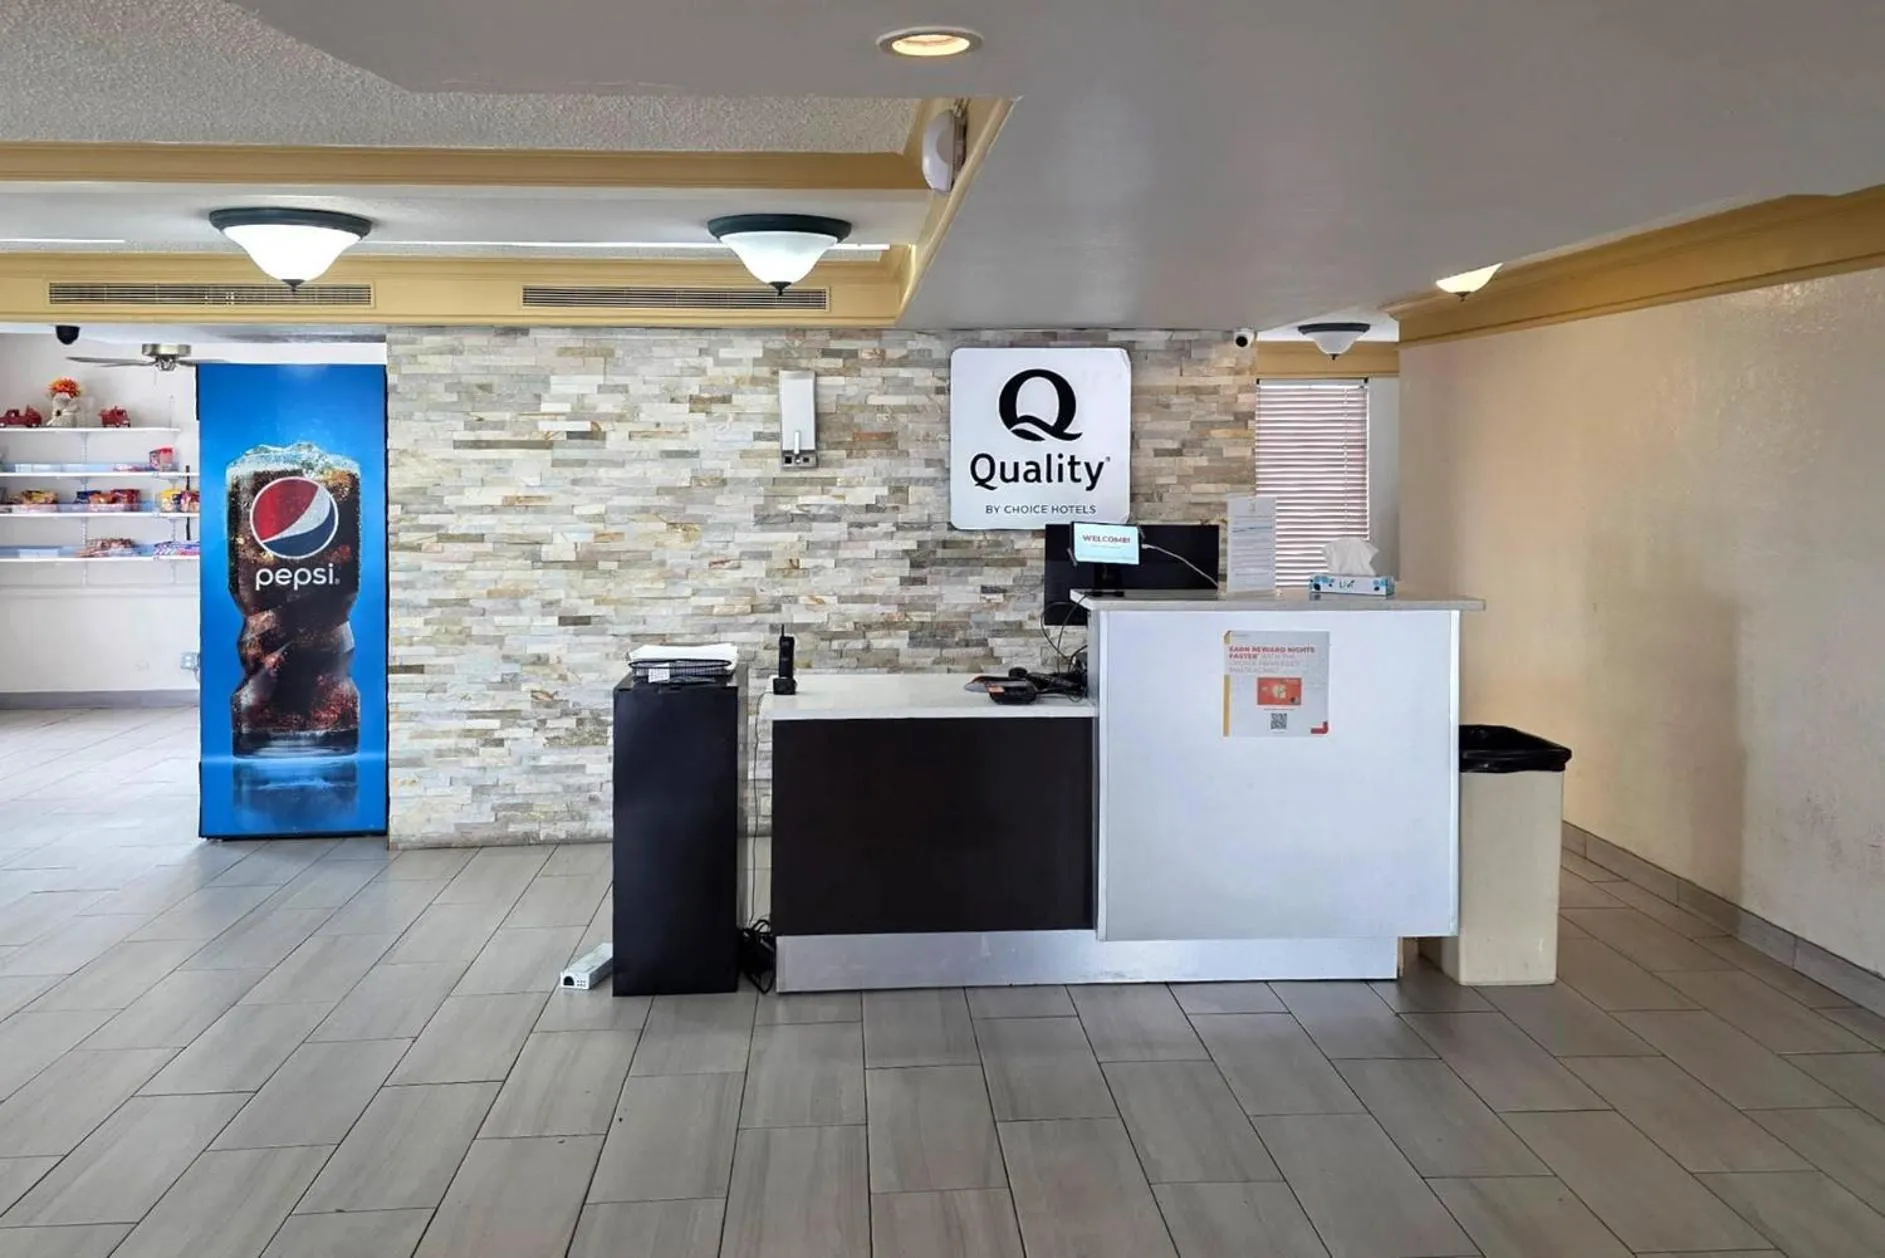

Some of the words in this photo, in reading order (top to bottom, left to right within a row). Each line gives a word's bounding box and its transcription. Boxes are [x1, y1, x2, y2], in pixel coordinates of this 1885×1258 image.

[999, 368, 1083, 442] Q
[969, 452, 1105, 492] Quality
[985, 504, 1000, 514] BY
[1003, 504, 1048, 514] CHOICE
[1051, 504, 1097, 515] HOTELS
[255, 562, 334, 591] pepsi
